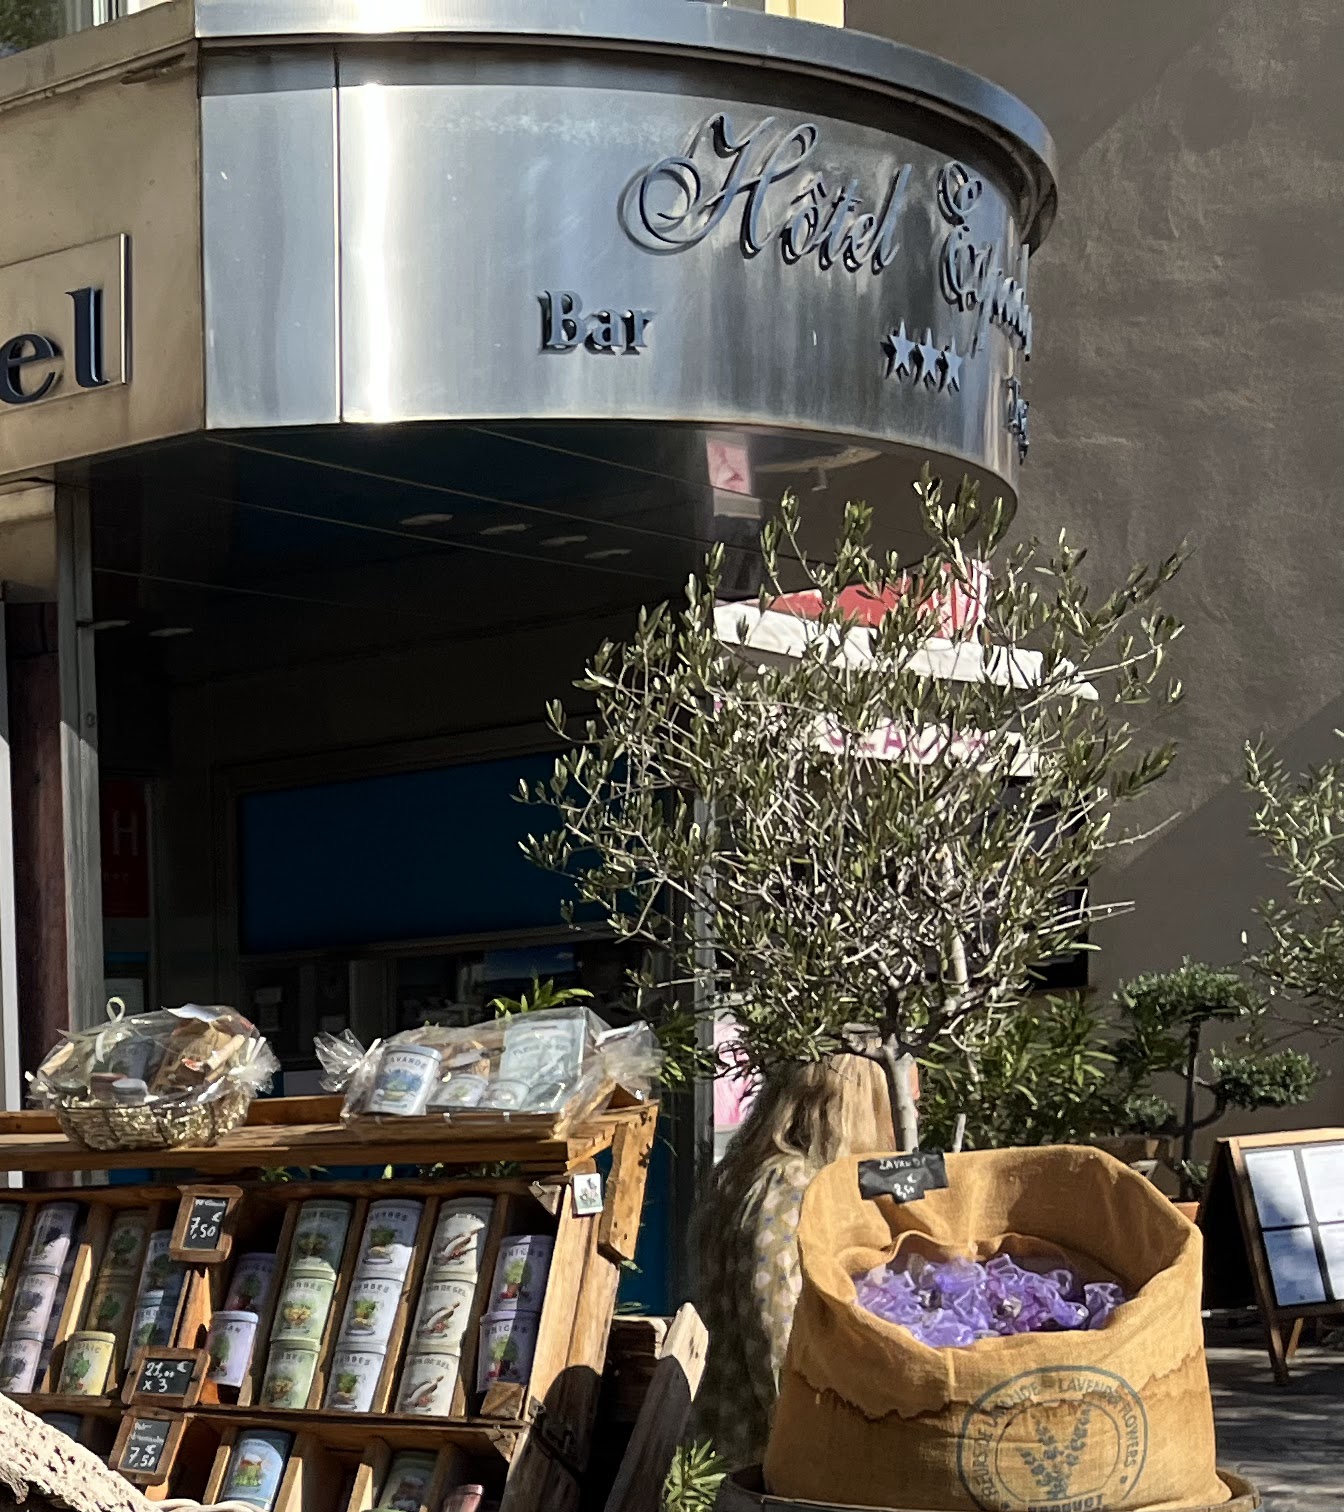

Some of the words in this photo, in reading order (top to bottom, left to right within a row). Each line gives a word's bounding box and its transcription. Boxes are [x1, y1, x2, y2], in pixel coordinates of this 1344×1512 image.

[538, 290, 654, 356] Bar
[189, 1216, 217, 1240] 7,50
[158, 1378, 168, 1393] 3
